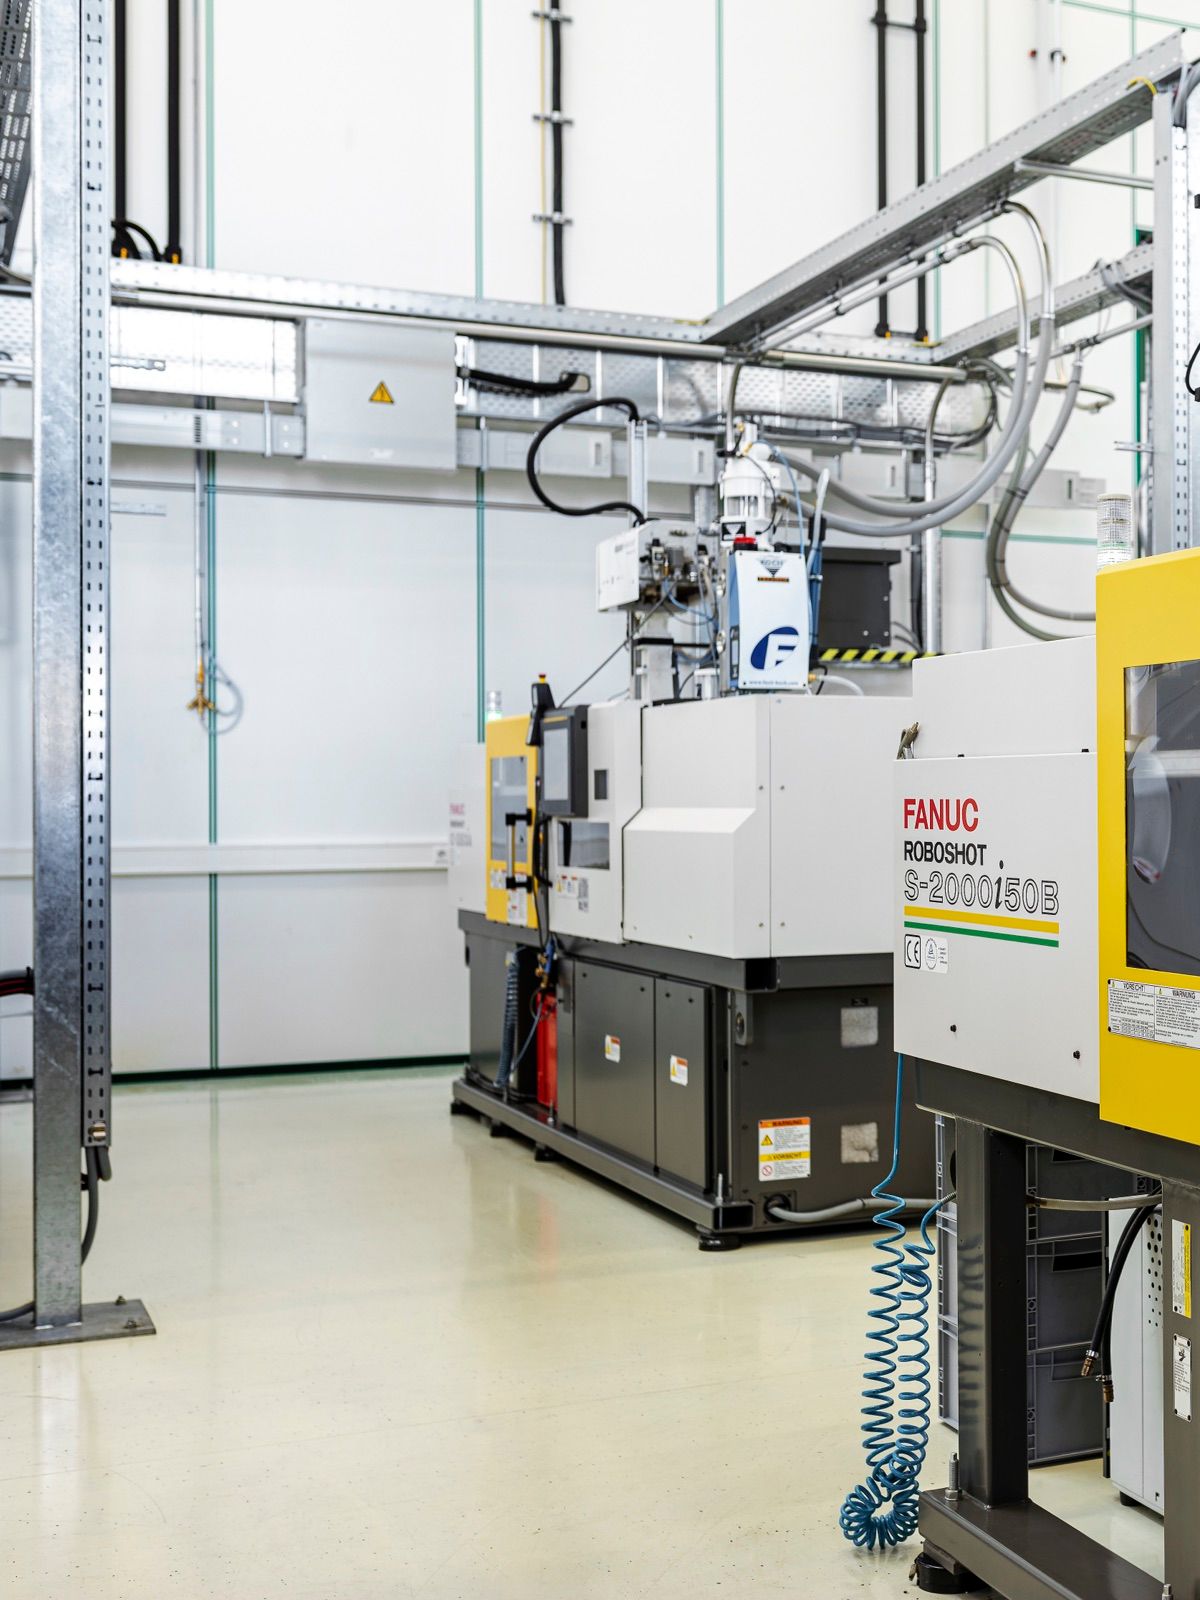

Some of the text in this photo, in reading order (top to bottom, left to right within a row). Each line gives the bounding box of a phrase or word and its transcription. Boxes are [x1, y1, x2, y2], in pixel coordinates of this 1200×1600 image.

[904, 798, 979, 832] FANUC
[904, 840, 987, 866] ROBOSHOT
[904, 860, 1060, 916] S-2000i50B
[907, 941, 919, 964] CE
[1172, 990, 1196, 999] WARNUNG
